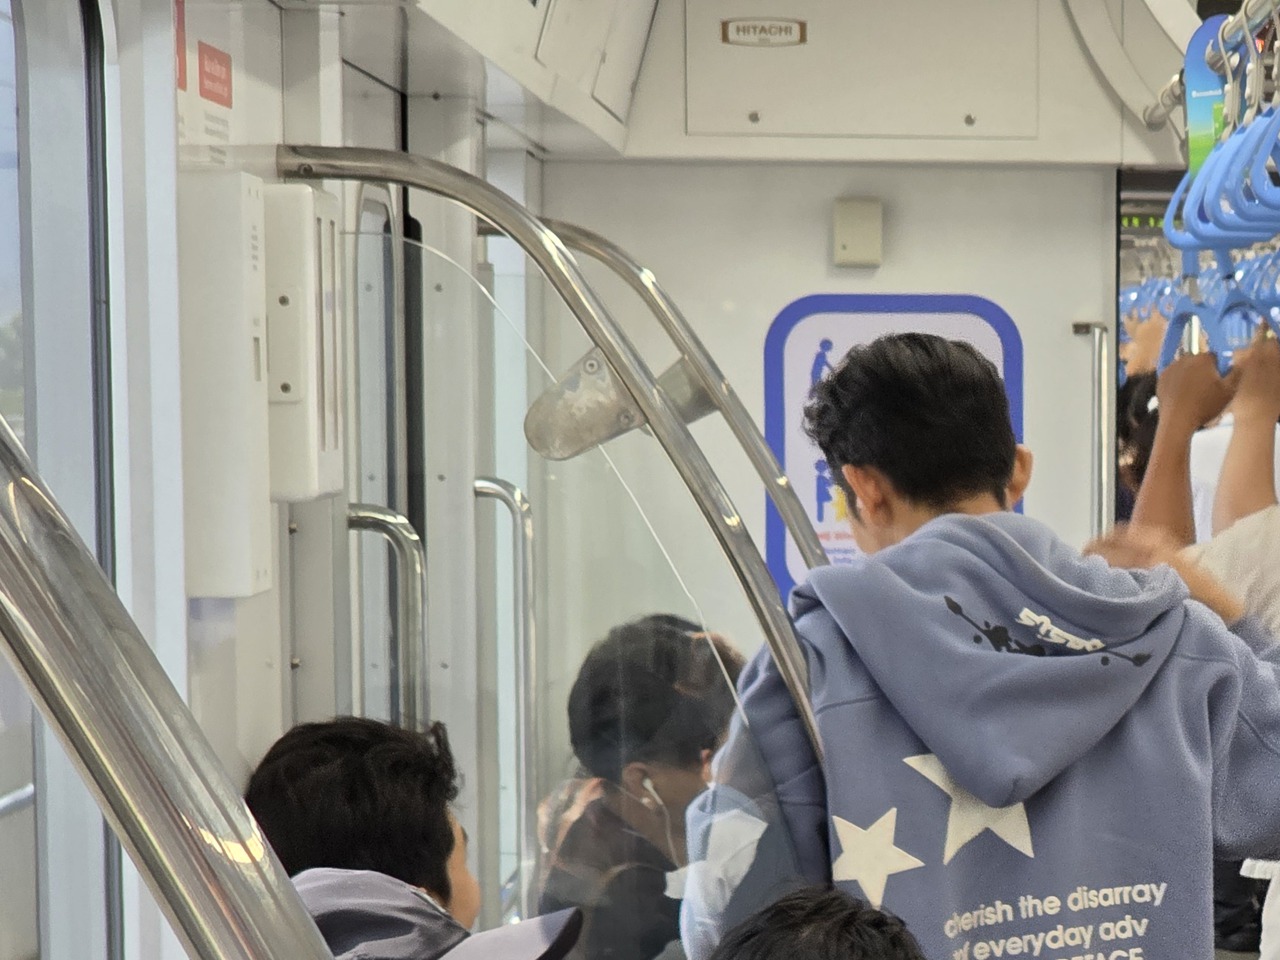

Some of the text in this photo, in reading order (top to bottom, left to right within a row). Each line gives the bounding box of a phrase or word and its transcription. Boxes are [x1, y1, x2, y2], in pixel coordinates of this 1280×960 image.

[736, 25, 793, 36] HITACHI
[1018, 894, 1061, 919] the
[1067, 882, 1168, 911] disarray
[973, 924, 1094, 960] everyday
[1099, 915, 1149, 941] adv
